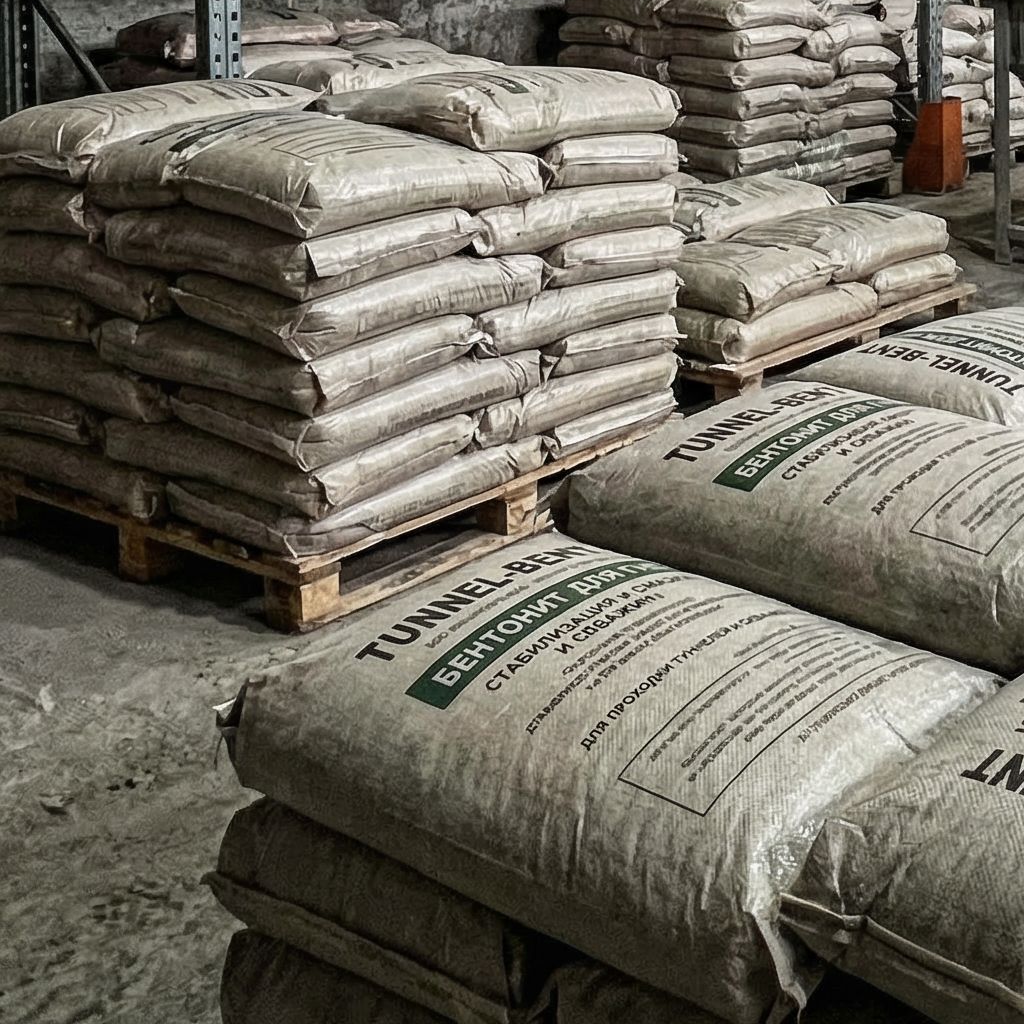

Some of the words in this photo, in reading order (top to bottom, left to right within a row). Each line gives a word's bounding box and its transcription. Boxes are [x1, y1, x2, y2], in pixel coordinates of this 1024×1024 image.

[856, 343, 1024, 396] TUNNEL-BENT
[663, 387, 848, 462] TUNNEL-BENT
[432, 590, 569, 687] БЕНТОНИТ
[567, 569, 621, 596] ДЛЯ
[485, 595, 617, 692] СТАБИЛИЗАЦИЯ
[554, 642, 575, 655] И
